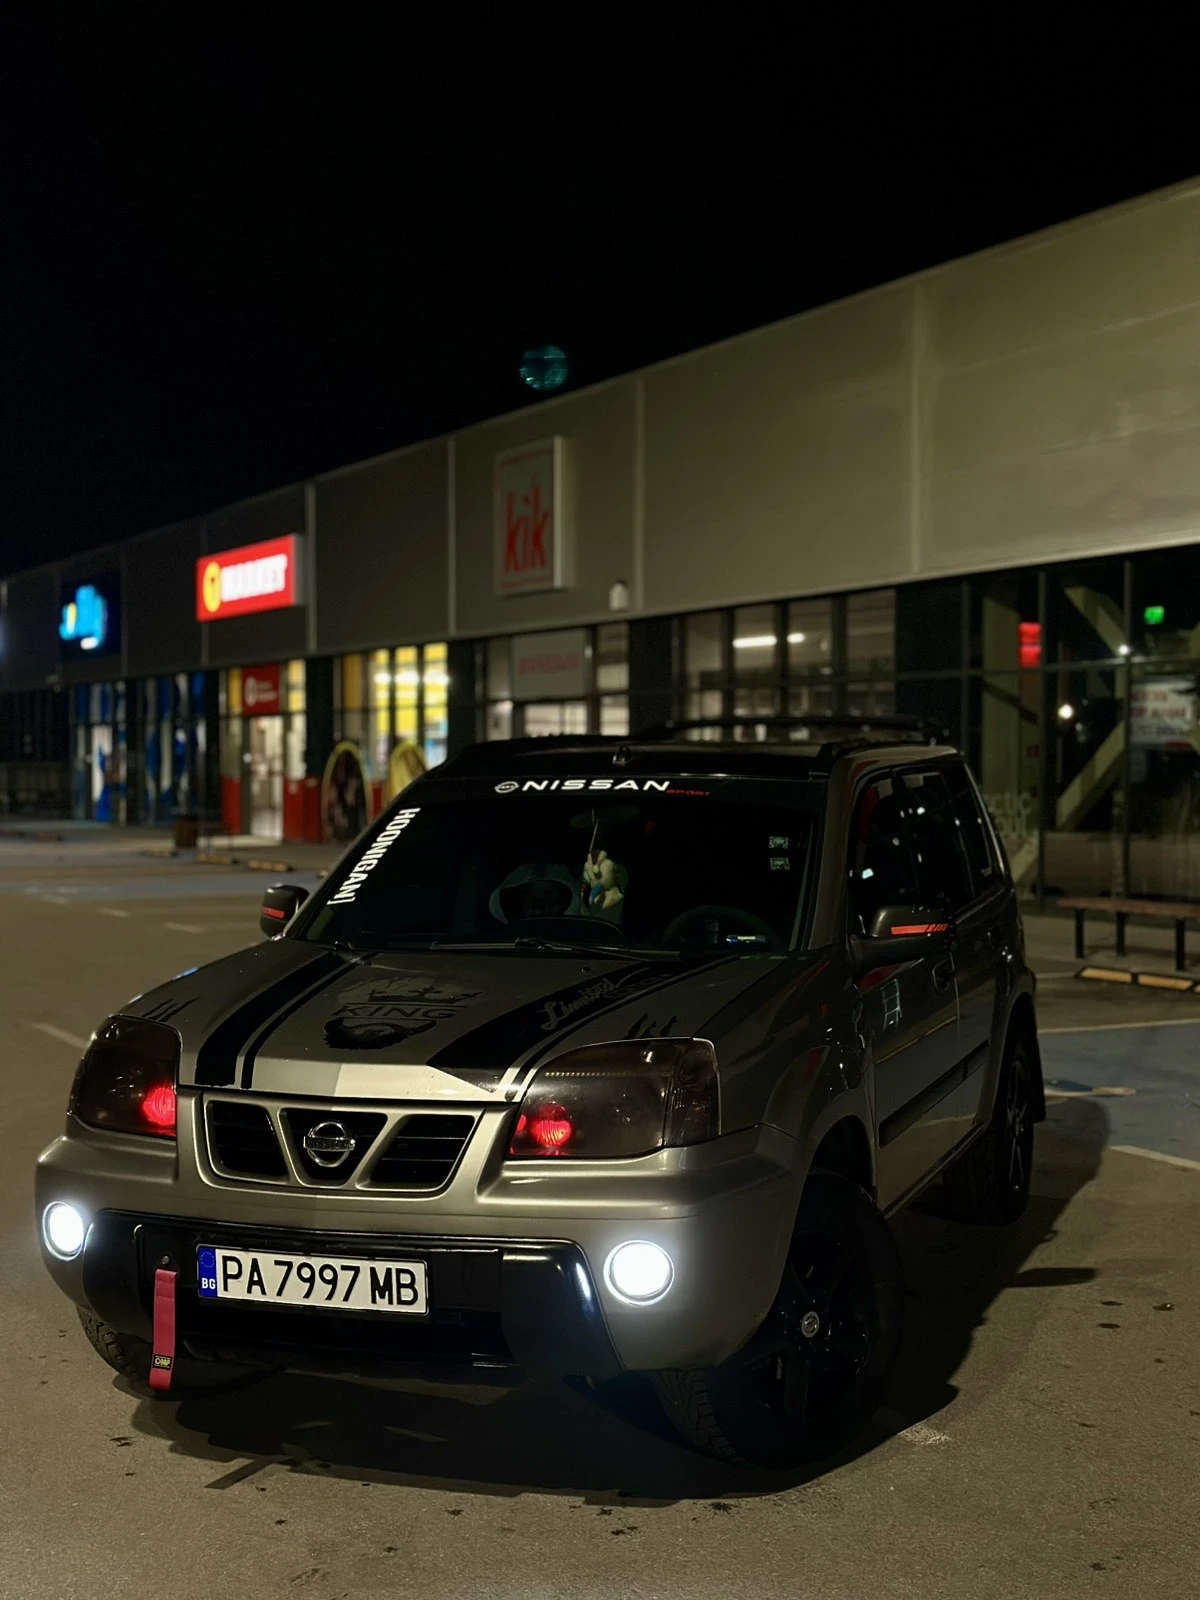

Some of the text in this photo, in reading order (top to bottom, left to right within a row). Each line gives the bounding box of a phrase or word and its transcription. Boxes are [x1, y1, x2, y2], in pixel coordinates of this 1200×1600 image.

[503, 480, 549, 575] kik
[522, 780, 671, 791] NISSAN
[331, 1005, 457, 1019] KING
[201, 1277, 216, 1290] BG
[222, 1255, 419, 1306] PA 7997 MB
